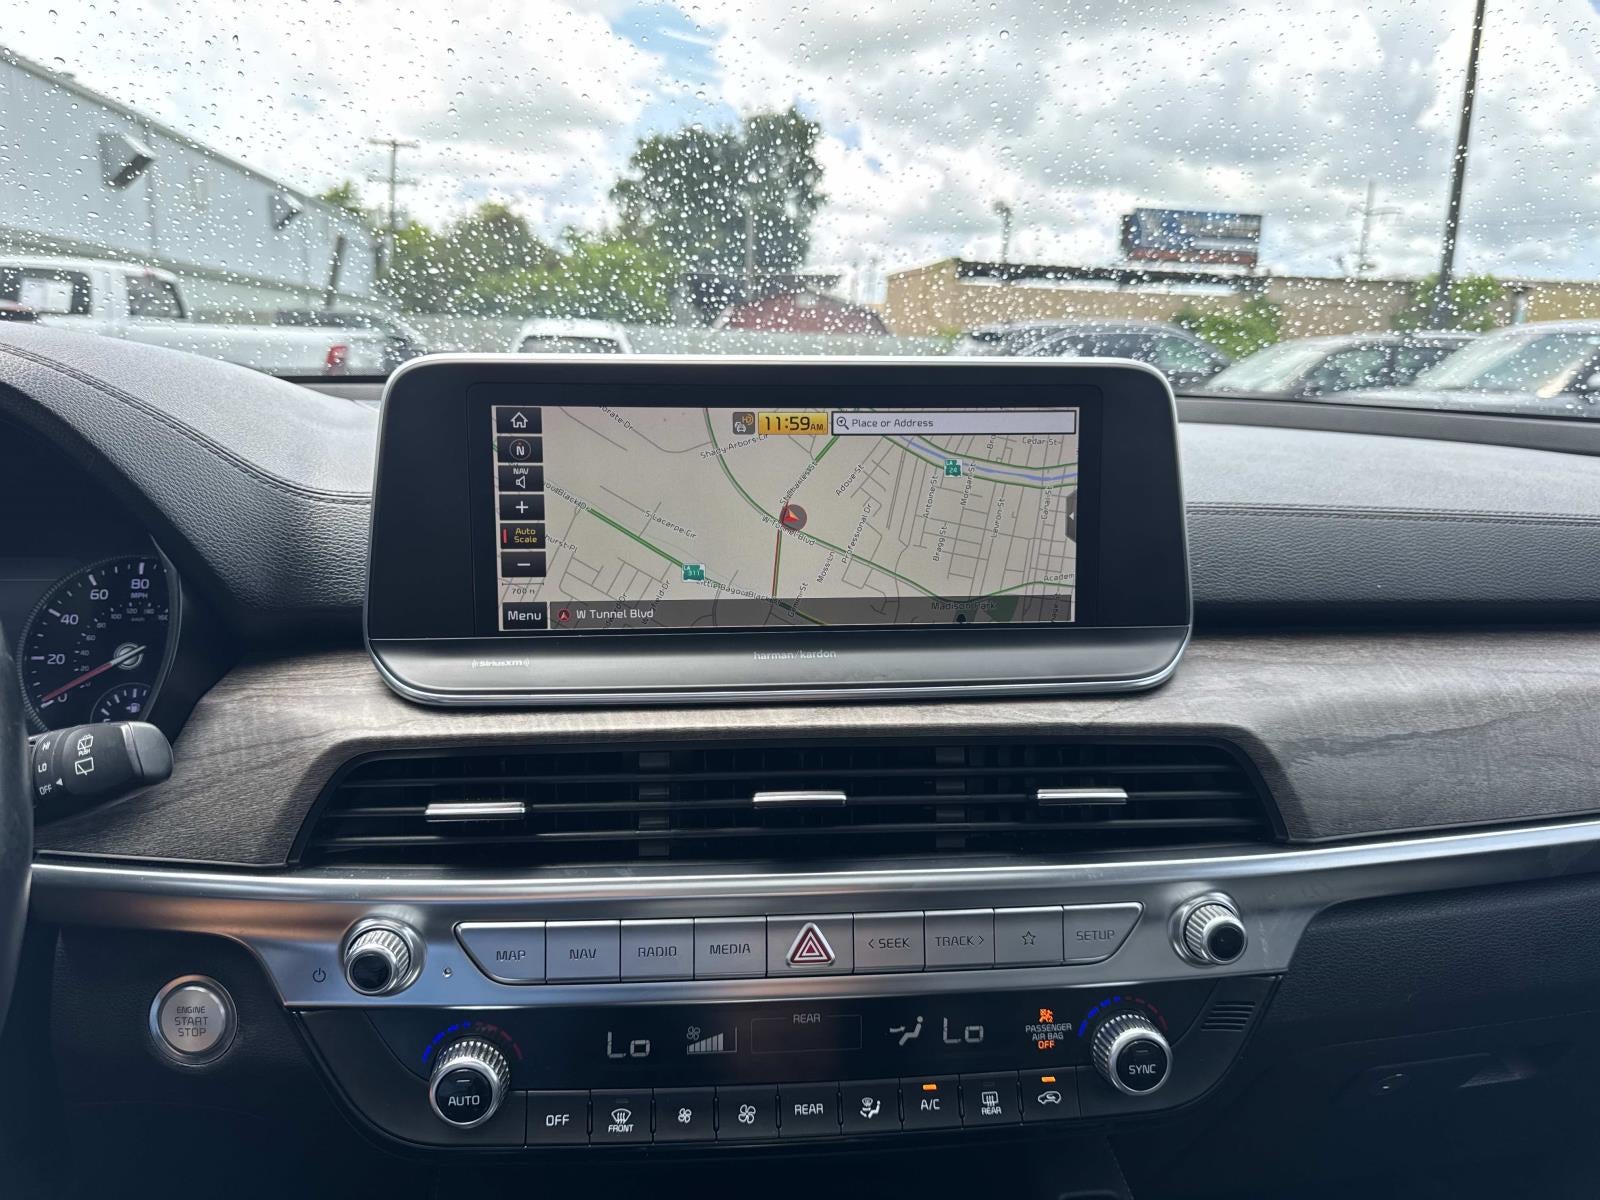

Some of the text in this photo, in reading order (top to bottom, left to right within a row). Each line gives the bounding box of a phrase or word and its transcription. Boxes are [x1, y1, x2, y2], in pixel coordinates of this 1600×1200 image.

[766, 416, 810, 431] 11:59
[852, 418, 934, 428] Place or Address
[1022, 436, 1046, 445] Cedar
[516, 446, 525, 456] N
[854, 464, 865, 475] St
[960, 475, 973, 506] Morgan
[923, 486, 936, 519] Antoine
[515, 528, 536, 536] Auto
[842, 503, 873, 564] Professional Dr
[933, 525, 947, 562] Bragg St
[816, 563, 831, 583] Moss
[130, 579, 150, 590] 80
[90, 589, 109, 600] 60
[931, 602, 994, 610] Madison Park
[508, 610, 542, 621] Menu
[576, 608, 654, 619] W Tunnel Blvd
[60, 614, 79, 625] 40
[47, 654, 66, 665] 20
[38, 762, 48, 773] LO
[39, 784, 52, 795] OFF
[1076, 929, 1115, 942] SETUP
[879, 937, 911, 949] SEEK
[936, 936, 973, 948] TRACK
[569, 948, 597, 961] NAV
[638, 946, 678, 959] RADIO
[709, 943, 752, 956] MEDIA
[496, 949, 527, 962] MAP
[176, 1006, 206, 1014] ENGINE
[174, 1017, 209, 1026] START
[793, 1013, 822, 1024] REAR
[177, 1027, 207, 1037] STOP
[1025, 1023, 1073, 1034] PASSENGER
[1032, 1031, 1064, 1041] AIR BAG
[1038, 1040, 1056, 1050] OFF
[1128, 1063, 1157, 1075] SYNC
[448, 1094, 480, 1107] AUTO
[920, 1099, 941, 1111] A/C
[795, 1104, 824, 1116] REAR
[981, 1106, 1002, 1116] REAR
[545, 1114, 570, 1127] OFF
[608, 1124, 634, 1134] FRONT
